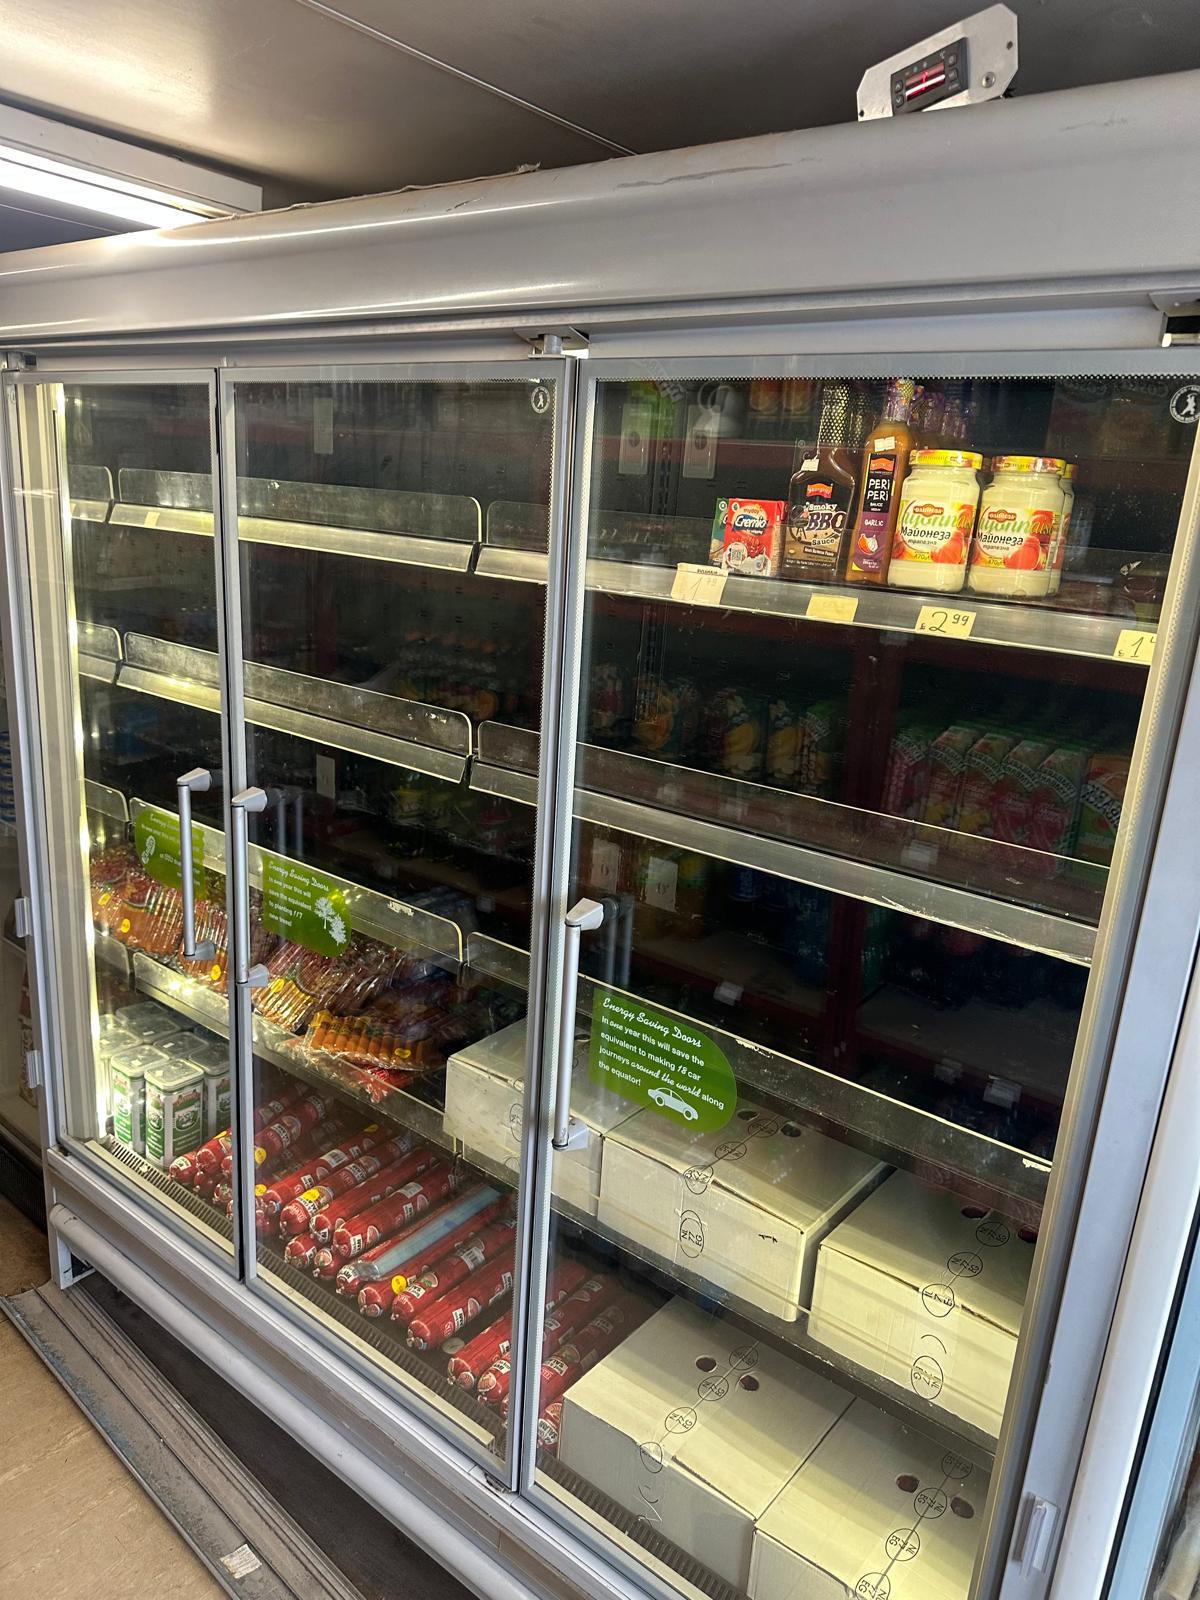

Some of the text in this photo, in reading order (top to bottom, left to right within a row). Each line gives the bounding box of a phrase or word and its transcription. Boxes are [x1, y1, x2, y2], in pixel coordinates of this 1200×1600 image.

[808, 503, 838, 511] Smoky
[735, 515, 767, 529] Cremio
[806, 511, 847, 533] BBQ
[864, 519, 884, 527] GARLIC
[900, 526, 951, 541] Майонеза
[811, 538, 836, 546] Sauce
[602, 997, 702, 1048] Energy Saving Doors
[601, 1016, 705, 1067] In one year this will save the
[600, 1031, 702, 1081] equivalent to making 18 car
[598, 1060, 641, 1086] the equator!
[599, 1046, 725, 1111] journeys around the world along
[689, 1231, 696, 1243] 77
[695, 1235, 703, 1246] EG
[714, 1388, 725, 1397] EG
[675, 1415, 685, 1425] 77
[682, 1419, 693, 1430] EG
[917, 1493, 929, 1505] EG
[926, 1498, 936, 1508] 77
[933, 1503, 945, 1513] NL
[888, 1534, 901, 1546] EG
[898, 1539, 908, 1550] 77
[905, 1543, 917, 1555] NL
[858, 1579, 871, 1594] EG
[867, 1584, 878, 1599] 77
